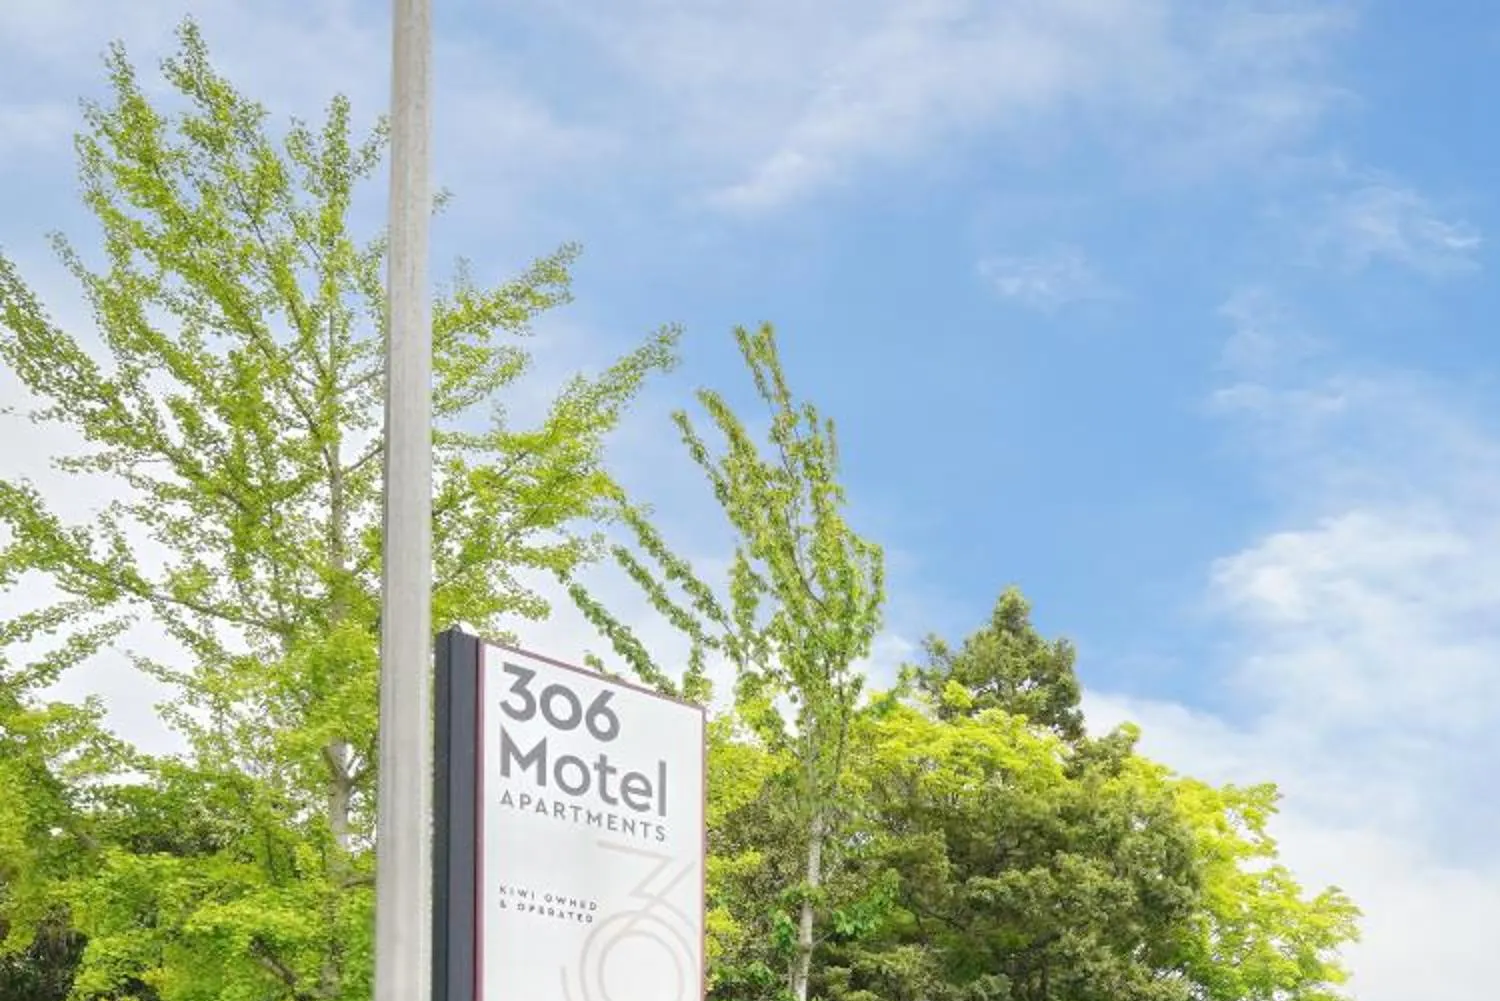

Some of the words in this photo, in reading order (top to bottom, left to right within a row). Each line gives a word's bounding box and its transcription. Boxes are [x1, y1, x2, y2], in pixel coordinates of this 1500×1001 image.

[500, 661, 621, 742] 306
[500, 725, 668, 817] Motel
[500, 789, 667, 842] APARTMENTS
[499, 885, 535, 900] KIWI
